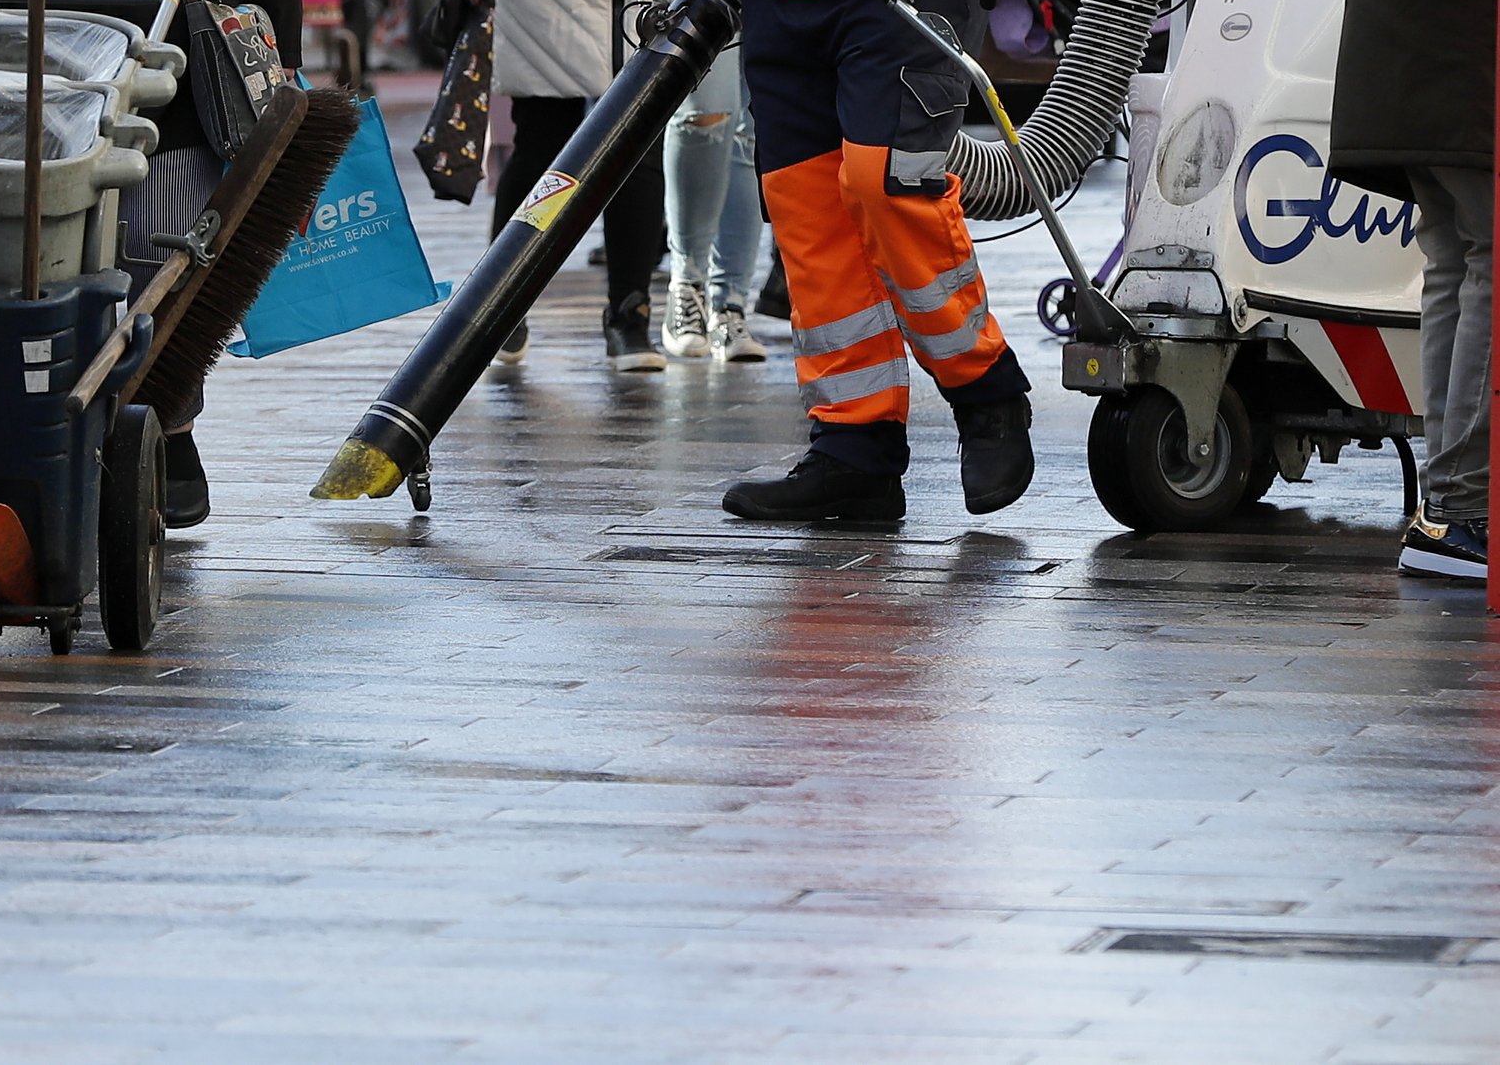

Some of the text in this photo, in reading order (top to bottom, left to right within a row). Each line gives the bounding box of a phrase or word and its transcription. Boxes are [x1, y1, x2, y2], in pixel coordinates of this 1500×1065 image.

[298, 235, 338, 258] HOME
[344, 219, 390, 243] BEAUTY
[288, 245, 359, 273] www.savers.co.uk
